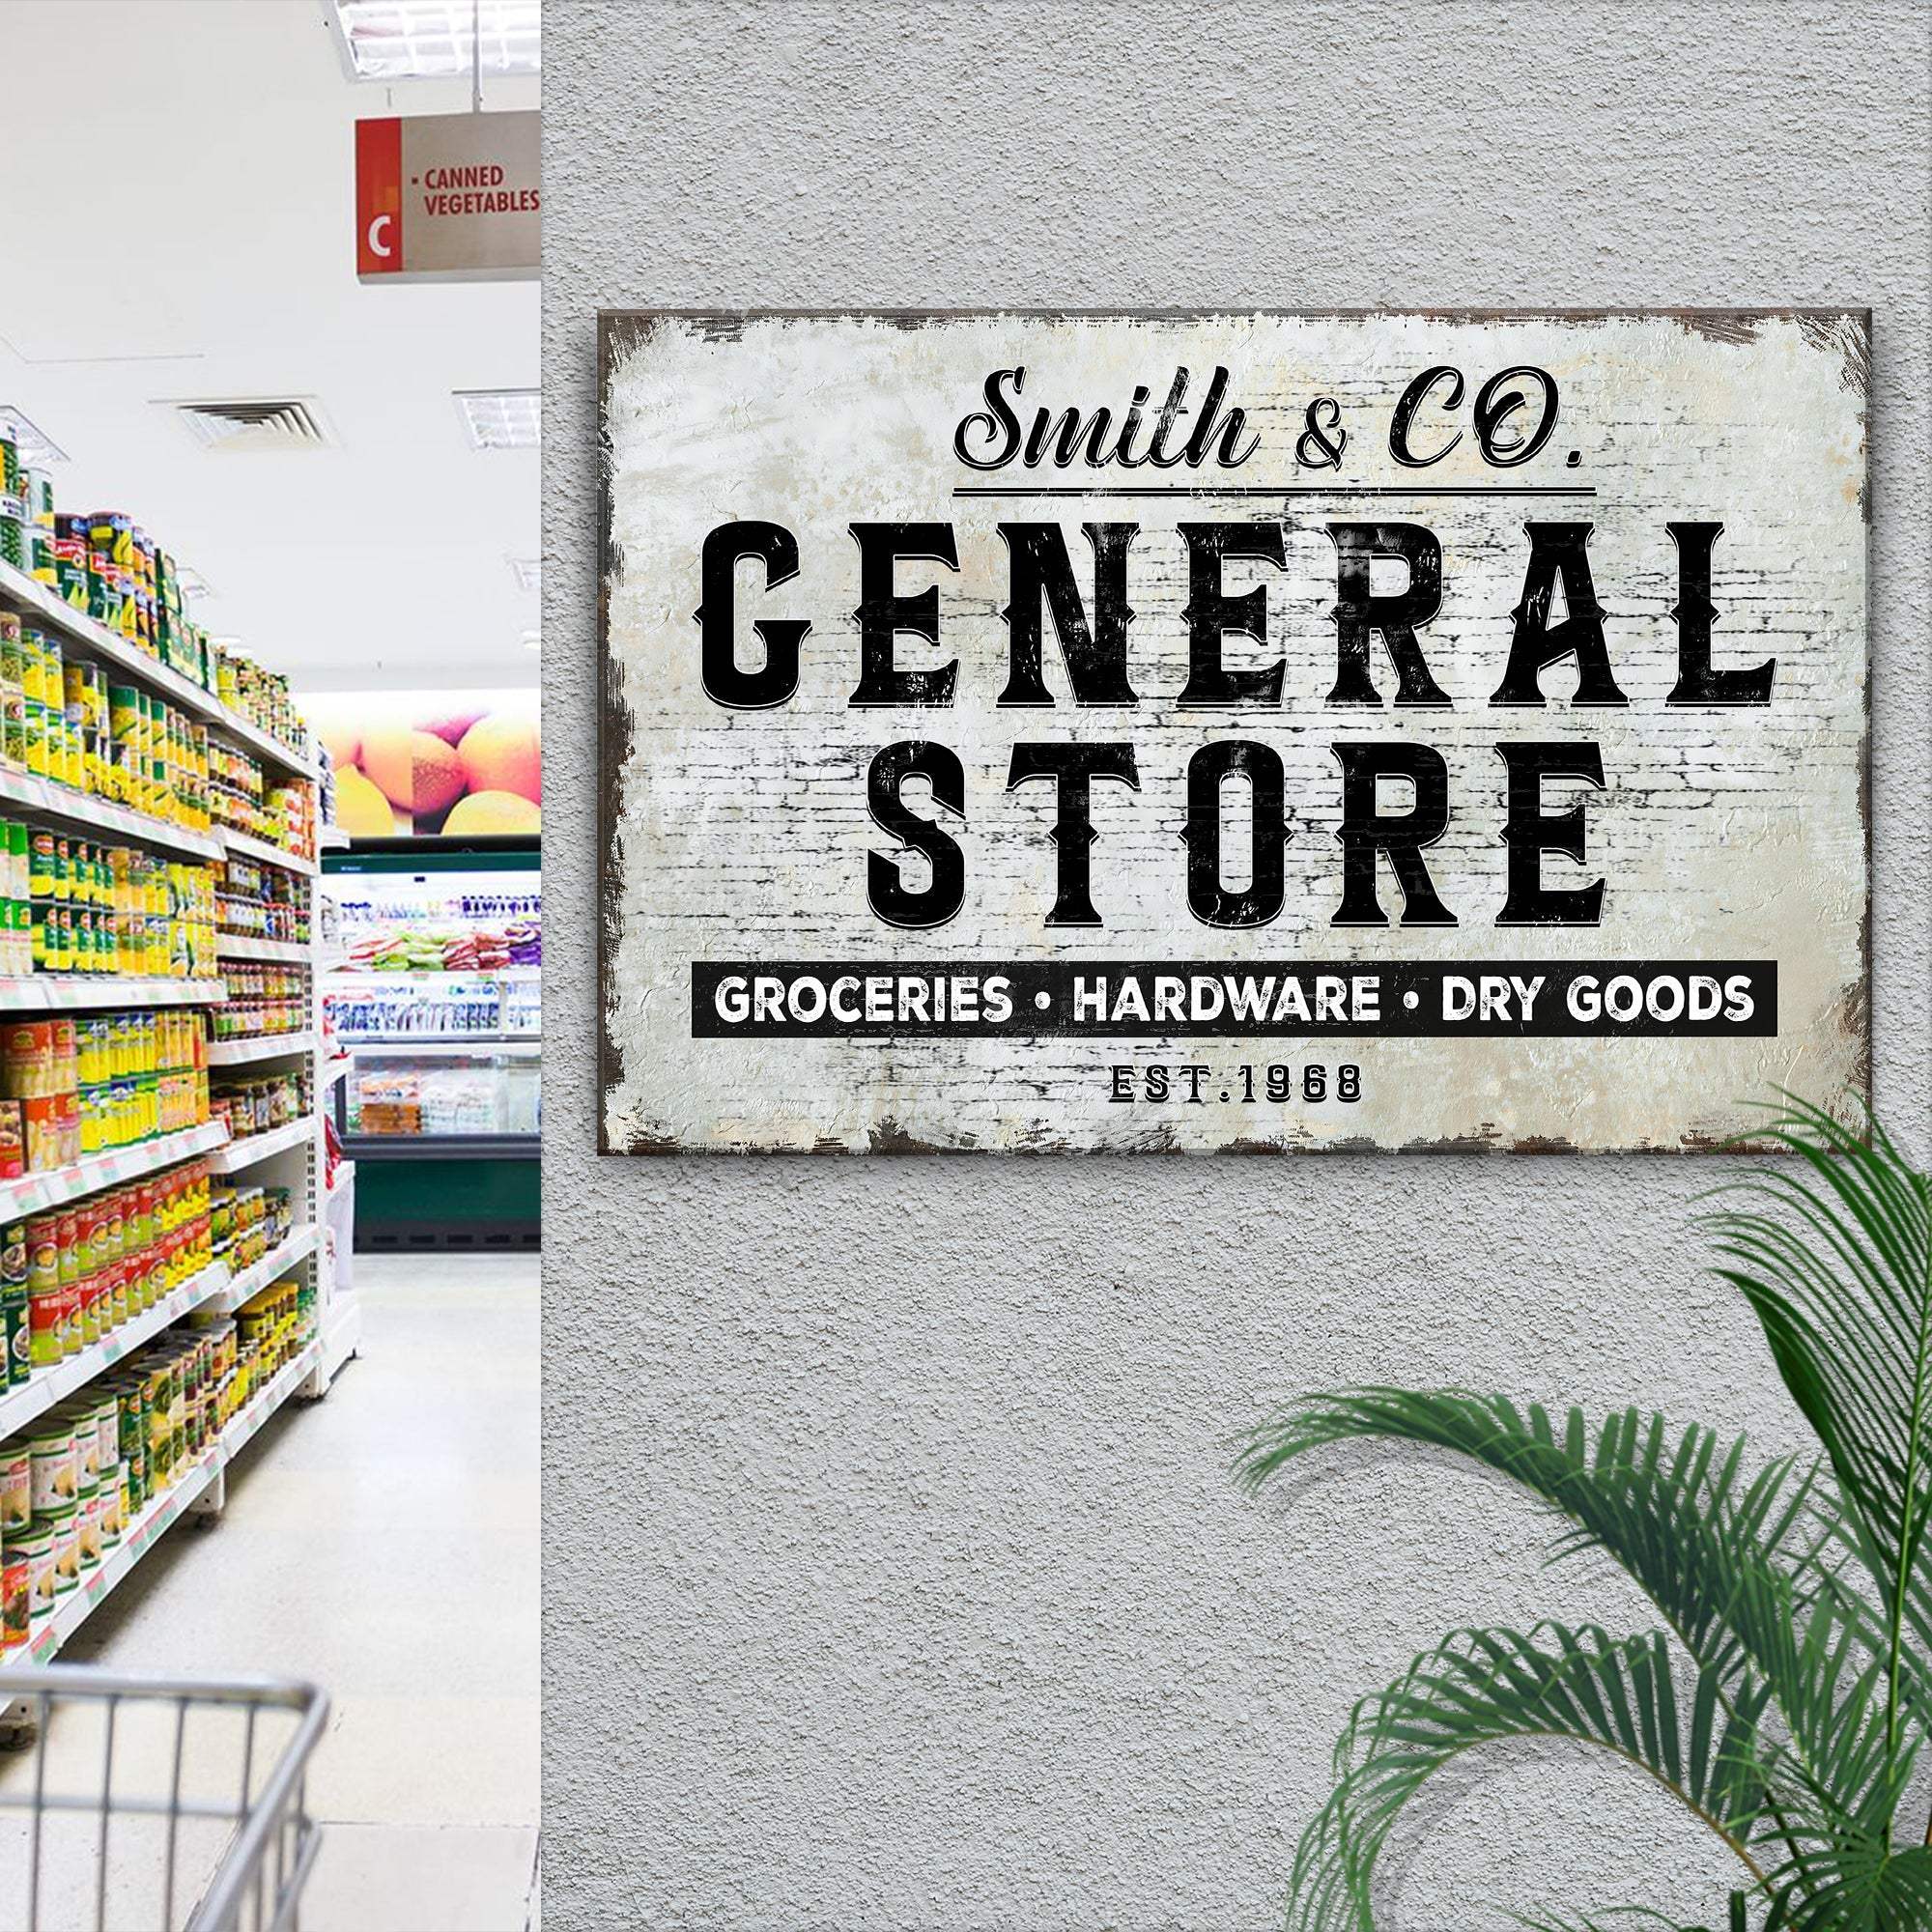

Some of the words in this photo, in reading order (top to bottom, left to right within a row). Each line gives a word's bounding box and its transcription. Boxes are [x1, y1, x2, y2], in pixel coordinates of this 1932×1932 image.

[425, 165, 503, 189] CANNED
[424, 189, 540, 216] VEGETABLES
[368, 214, 391, 257] C
[952, 365, 1262, 472] Smith
[1294, 397, 1348, 471] &
[692, 521, 1778, 711] GENERAL
[866, 740, 1607, 929] STORE
[714, 975, 1013, 1023] GROCERIES
[1073, 976, 1381, 1022] HARDWARE
[1442, 976, 1548, 1021] DRY
[1566, 975, 1756, 1022] GOODS
